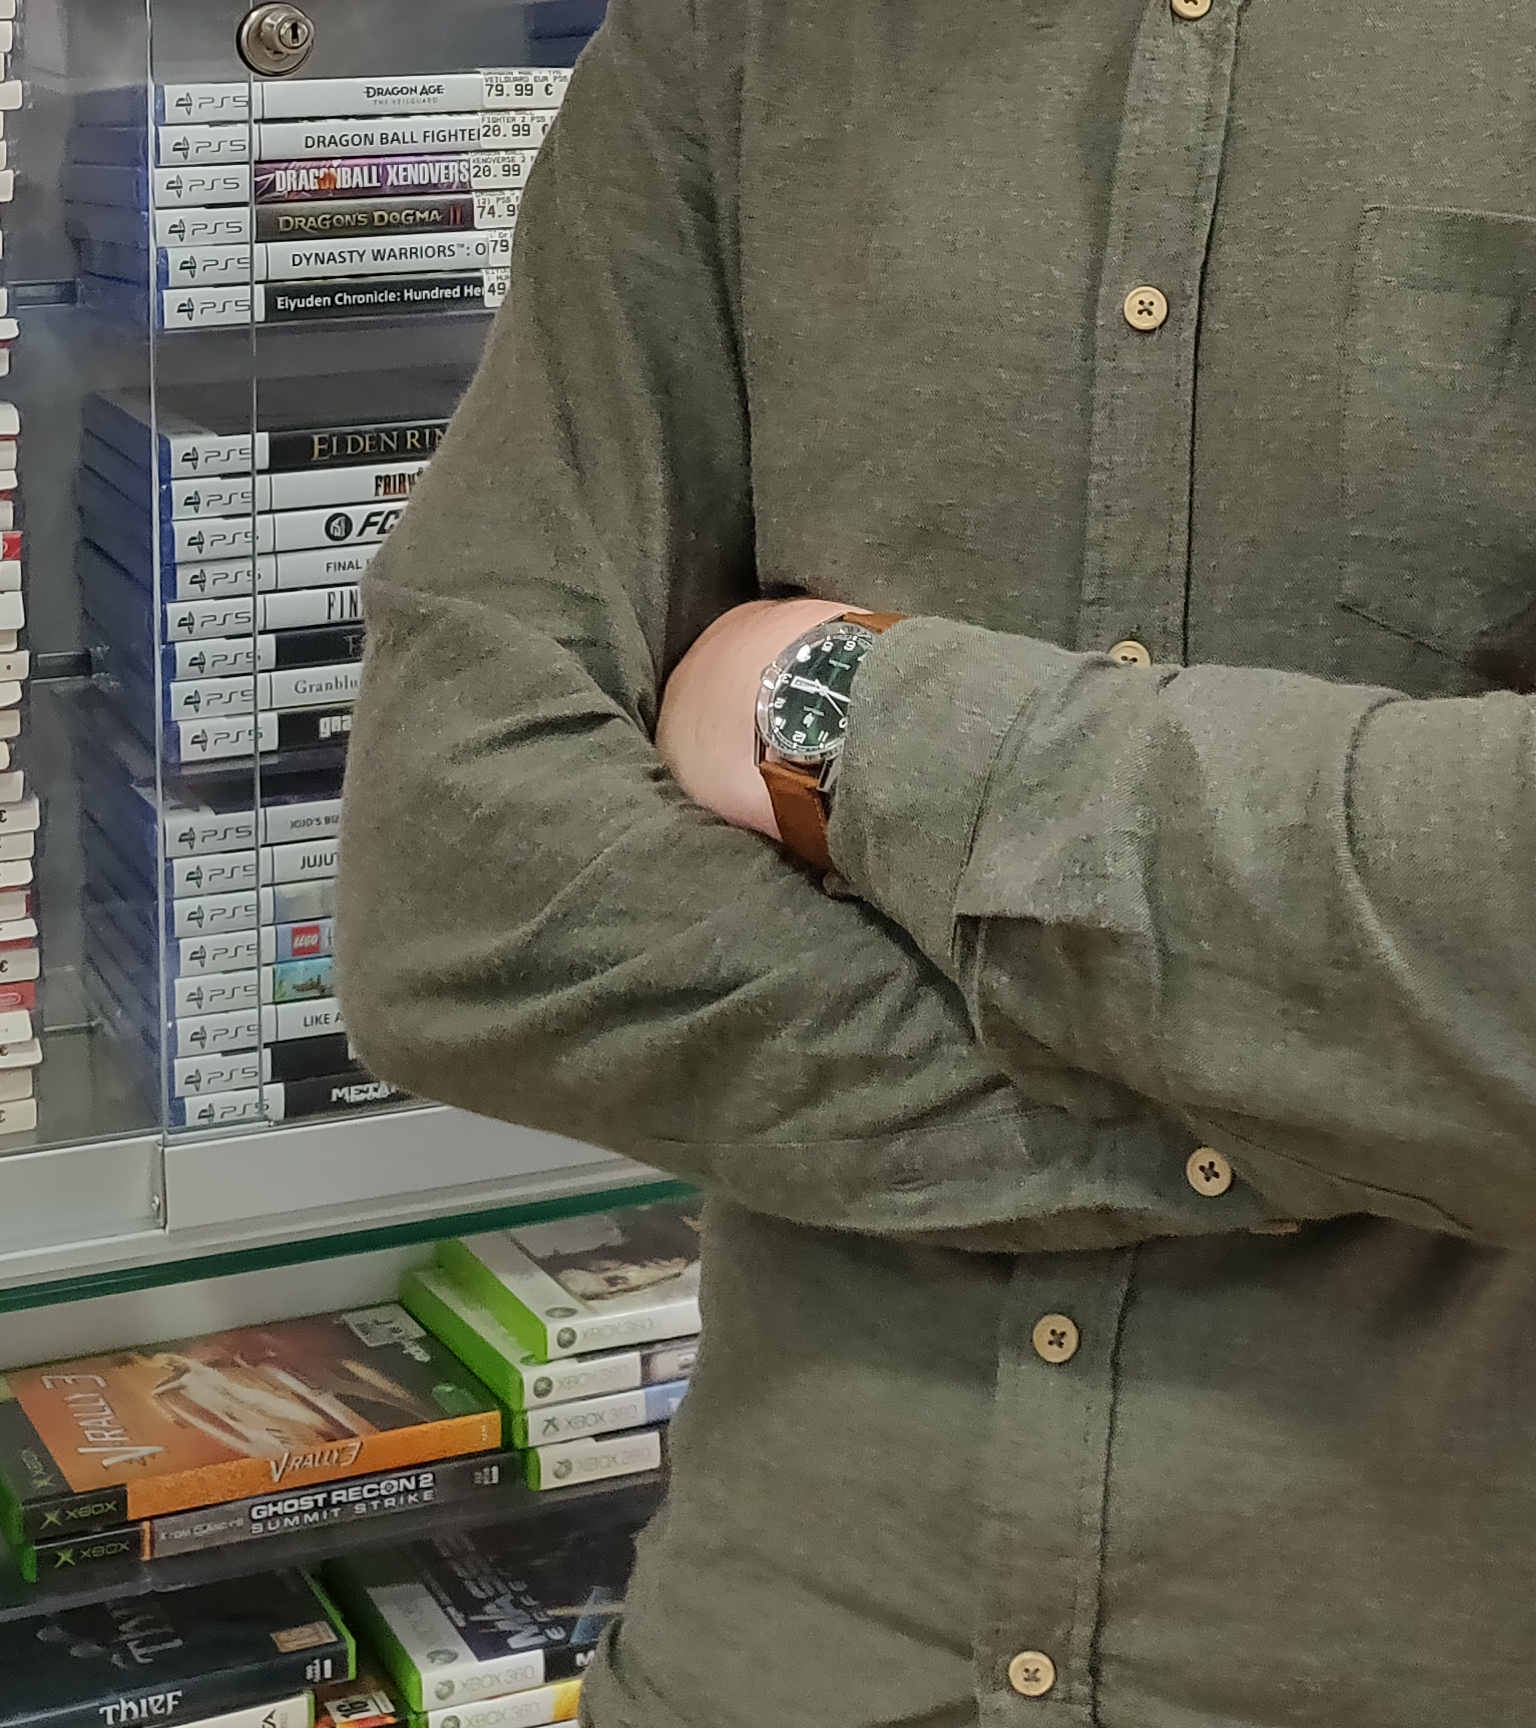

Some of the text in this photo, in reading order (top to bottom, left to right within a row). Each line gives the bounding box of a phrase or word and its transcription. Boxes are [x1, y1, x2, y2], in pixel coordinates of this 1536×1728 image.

[374, 209, 443, 226] DOGMA
[251, 1473, 434, 1521] GHOST RECON 2
[251, 1490, 435, 1534] SUMMIT STRIKE
[79, 1540, 129, 1560] XBOX
